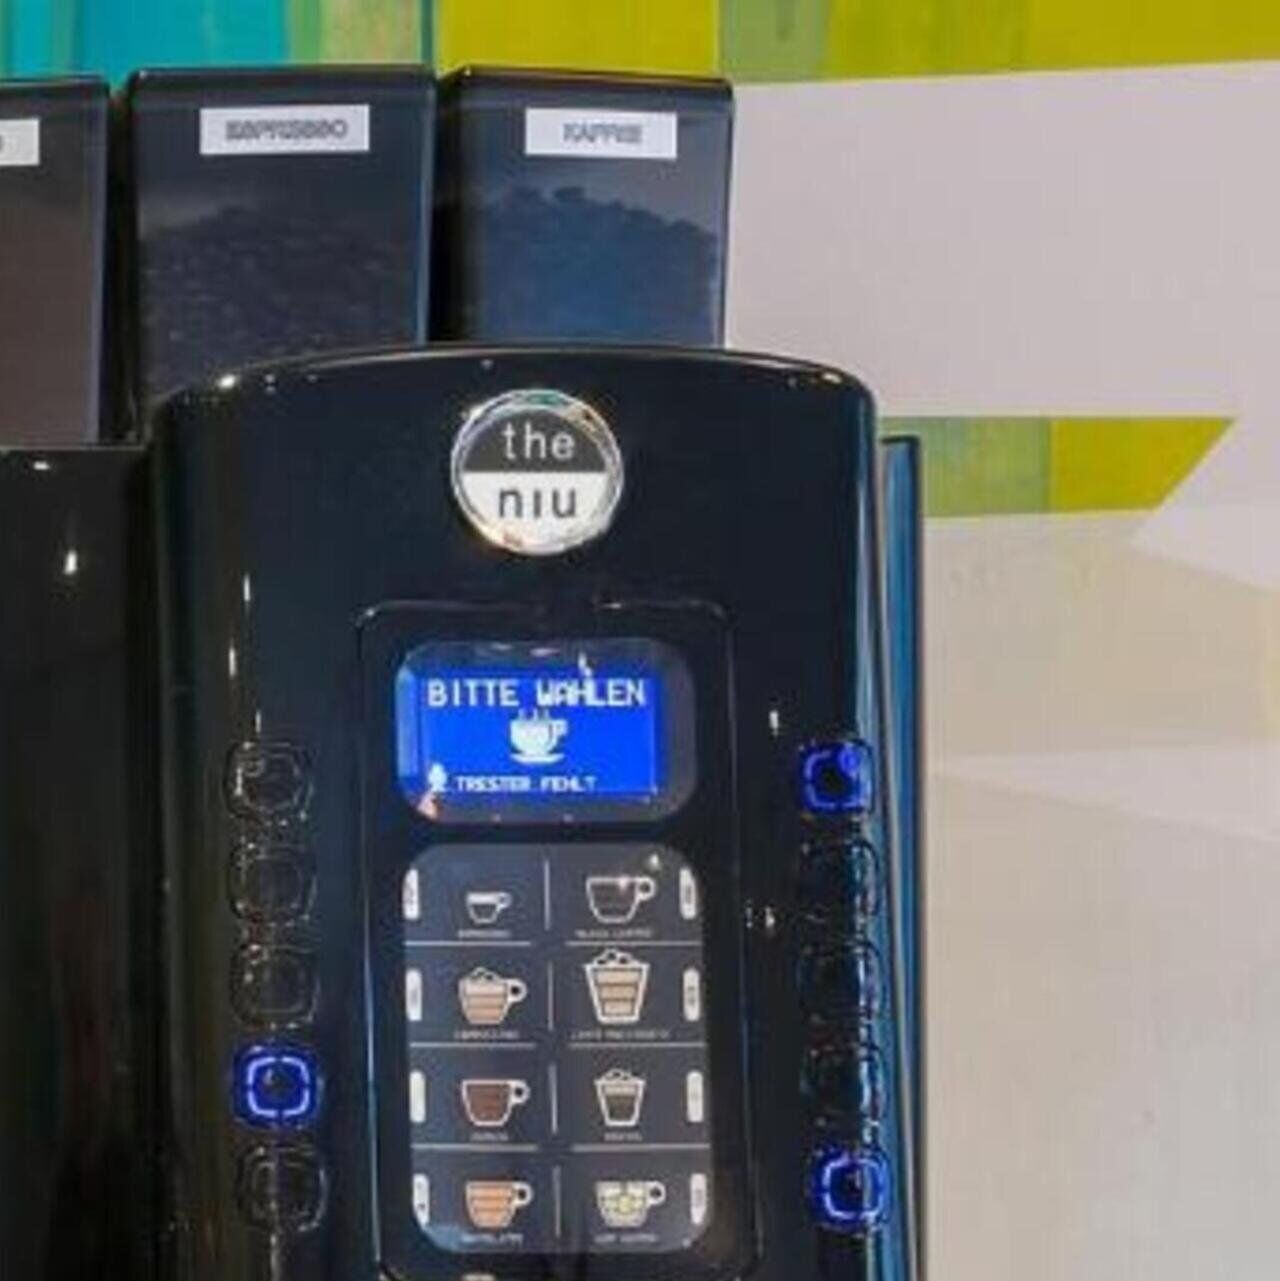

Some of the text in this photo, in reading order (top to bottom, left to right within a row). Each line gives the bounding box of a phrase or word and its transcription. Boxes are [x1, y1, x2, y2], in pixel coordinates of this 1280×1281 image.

[501, 422, 575, 461] the
[499, 488, 575, 518] niu
[427, 678, 520, 707] BITTE
